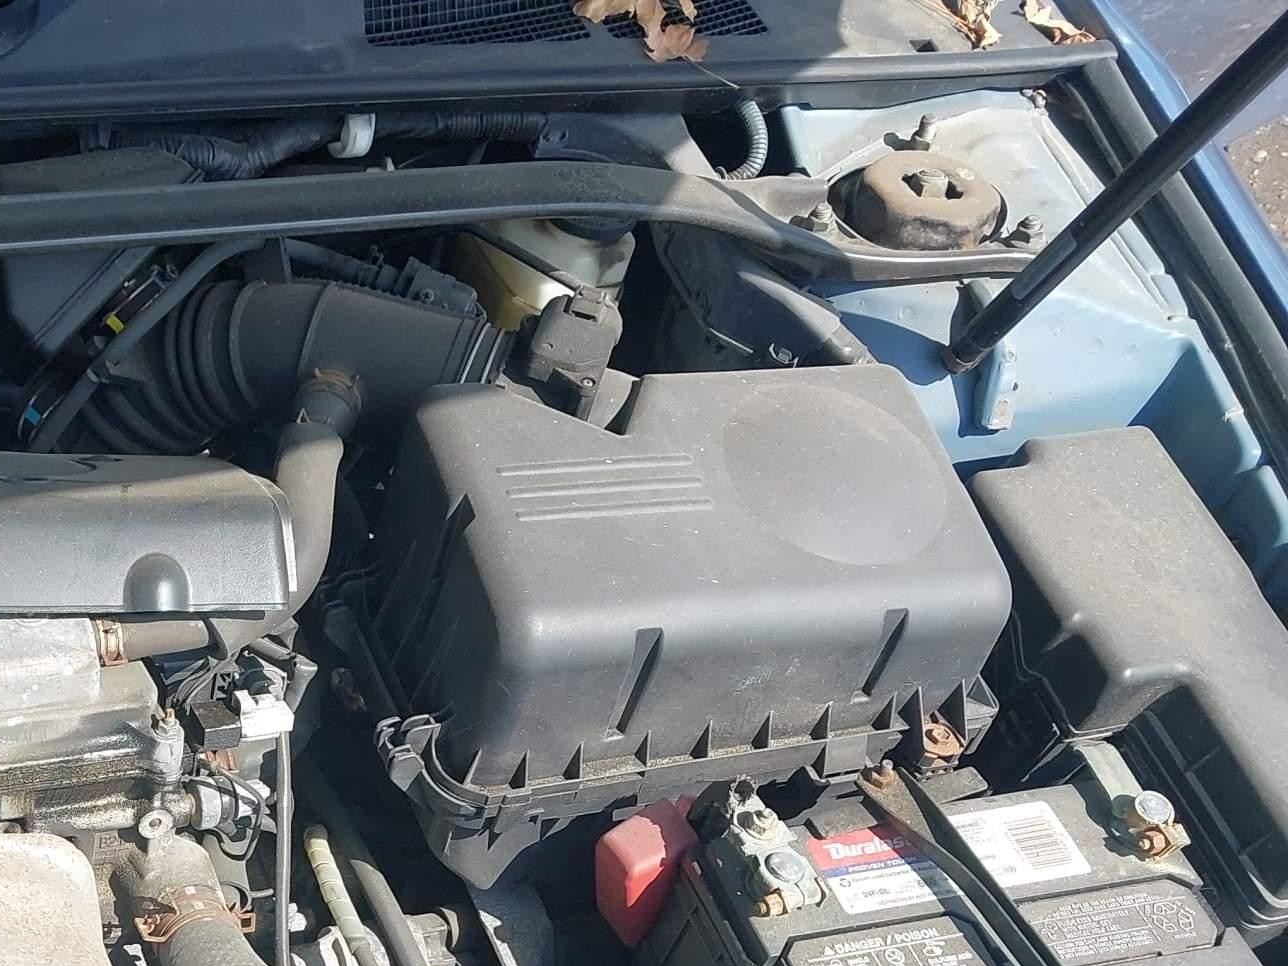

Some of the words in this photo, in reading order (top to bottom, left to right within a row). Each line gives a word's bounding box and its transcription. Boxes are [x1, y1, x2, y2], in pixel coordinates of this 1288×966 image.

[848, 863, 885, 873] PROVEN
[835, 937, 885, 954] DANGER
[893, 928, 939, 944] POISON
